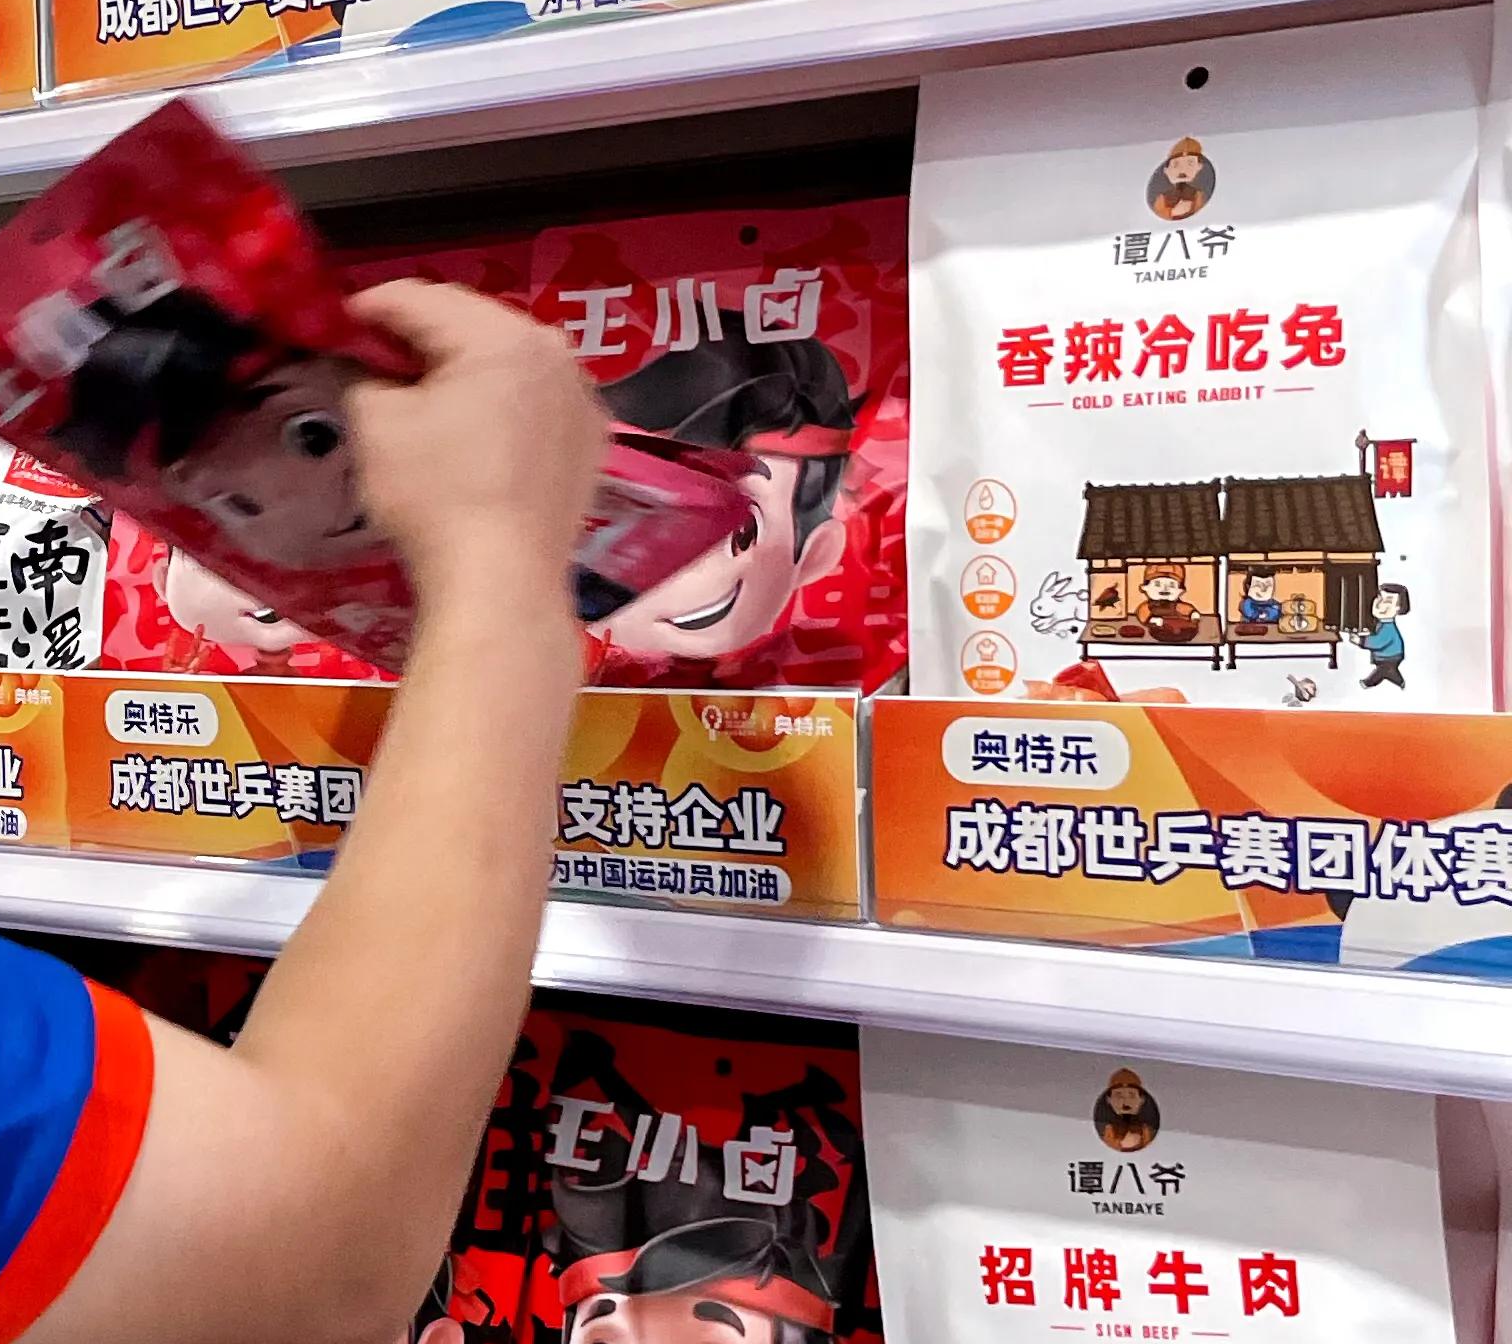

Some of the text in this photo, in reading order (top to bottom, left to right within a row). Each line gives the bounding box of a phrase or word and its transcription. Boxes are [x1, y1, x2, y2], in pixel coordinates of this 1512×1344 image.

[1113, 224, 1237, 267] 谭八爷
[1133, 265, 1209, 285] TANBAYE
[558, 267, 823, 357] 王小卤
[996, 302, 1346, 387] 香辣冷吃兔
[1072, 385, 1266, 411] COLD EATING RABBIT
[124, 701, 201, 736] 奥特乐
[972, 729, 1098, 774] 奥特乐
[549, 857, 780, 902] 为中国运动员加油
[544, 1095, 798, 1207] 王小卤
[1068, 1161, 1186, 1196] 谭八爷
[1092, 1201, 1165, 1217] TANBAYE
[979, 1245, 1301, 1317] 招牌牛肉
[1095, 1323, 1180, 1341] SIGN BEEF
